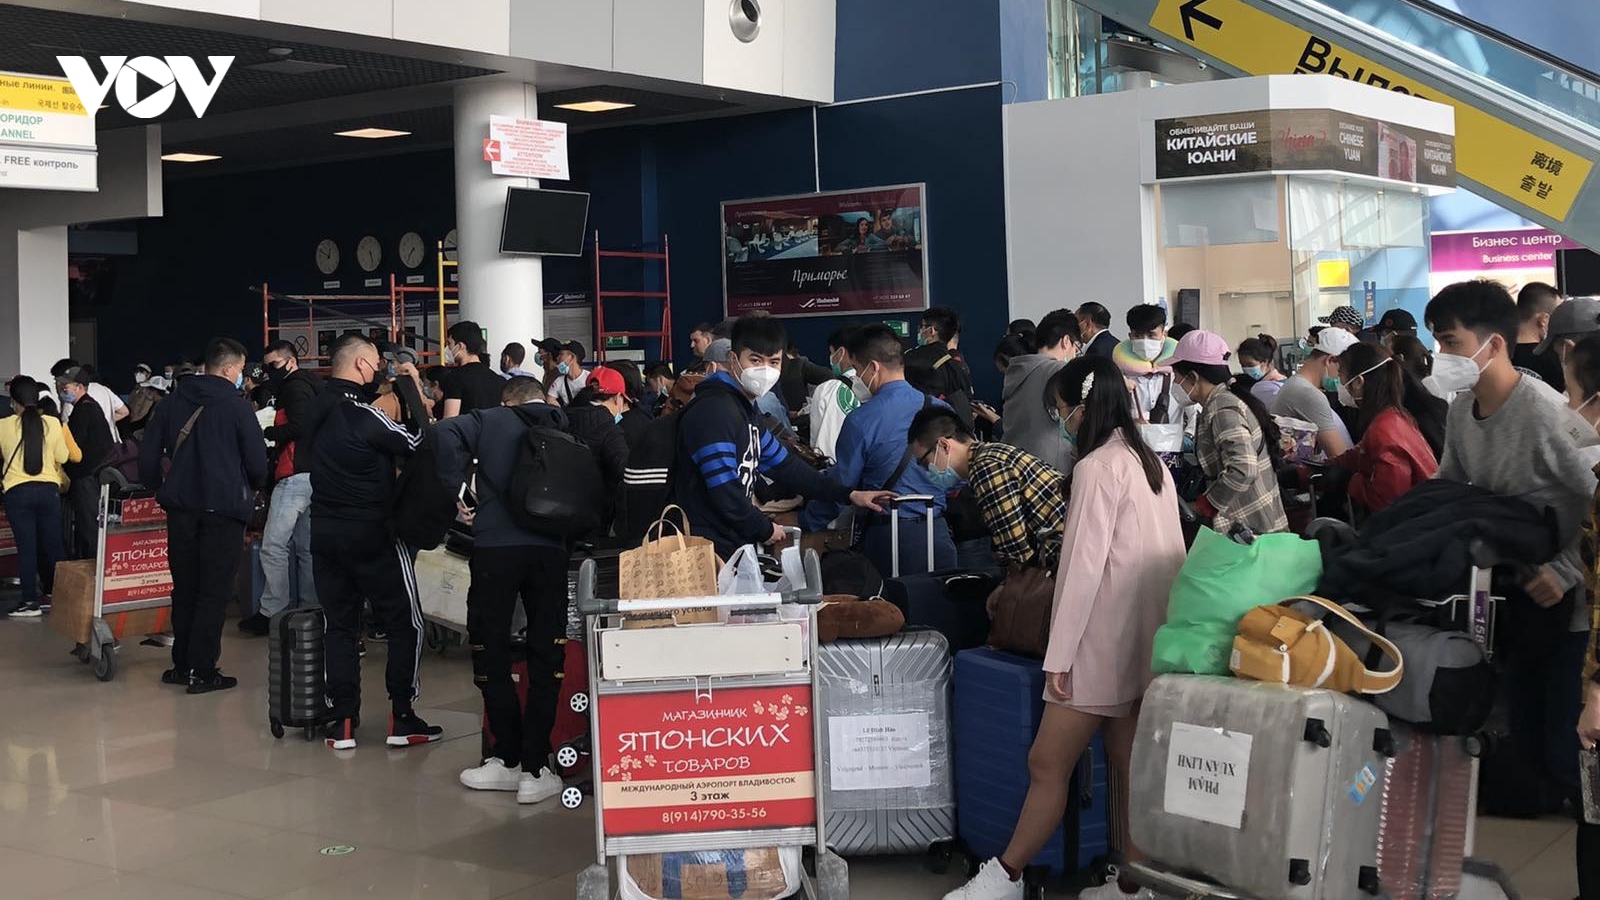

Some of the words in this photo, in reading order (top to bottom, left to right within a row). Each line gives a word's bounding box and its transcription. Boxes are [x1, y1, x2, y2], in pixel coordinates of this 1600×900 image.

[1169, 123, 1228, 136] ОБМЕНИВАЙТЕ
[1230, 122, 1255, 131] ВАШИ
[1166, 131, 1258, 151] КИТАЙСКИЕ
[4, 155, 31, 166] FREE
[33, 159, 79, 169] контроль
[1187, 149, 1236, 164] ЮАНИ
[1472, 237, 1518, 248] Бизнес
[1522, 234, 1562, 246] центр
[1482, 254, 1520, 263] Business
[1521, 252, 1553, 262] center
[792, 268, 849, 289] Приморье
[662, 708, 748, 722] МАГАЗИНЧИК
[618, 723, 790, 753] ЯПОНСКИХ
[662, 756, 750, 773] ТОВАРОВ
[1177, 754, 1203, 770] LINH
[621, 782, 694, 793] МЕЖДУНАРОДНЫЙ
[696, 780, 738, 790] АЭРОПОРТ
[738, 777, 796, 788] ВЛАДИВОСТОК
[690, 791, 698, 801] 3
[701, 791, 730, 801] этаж
[662, 807, 767, 824] 8(914)790-35-56
